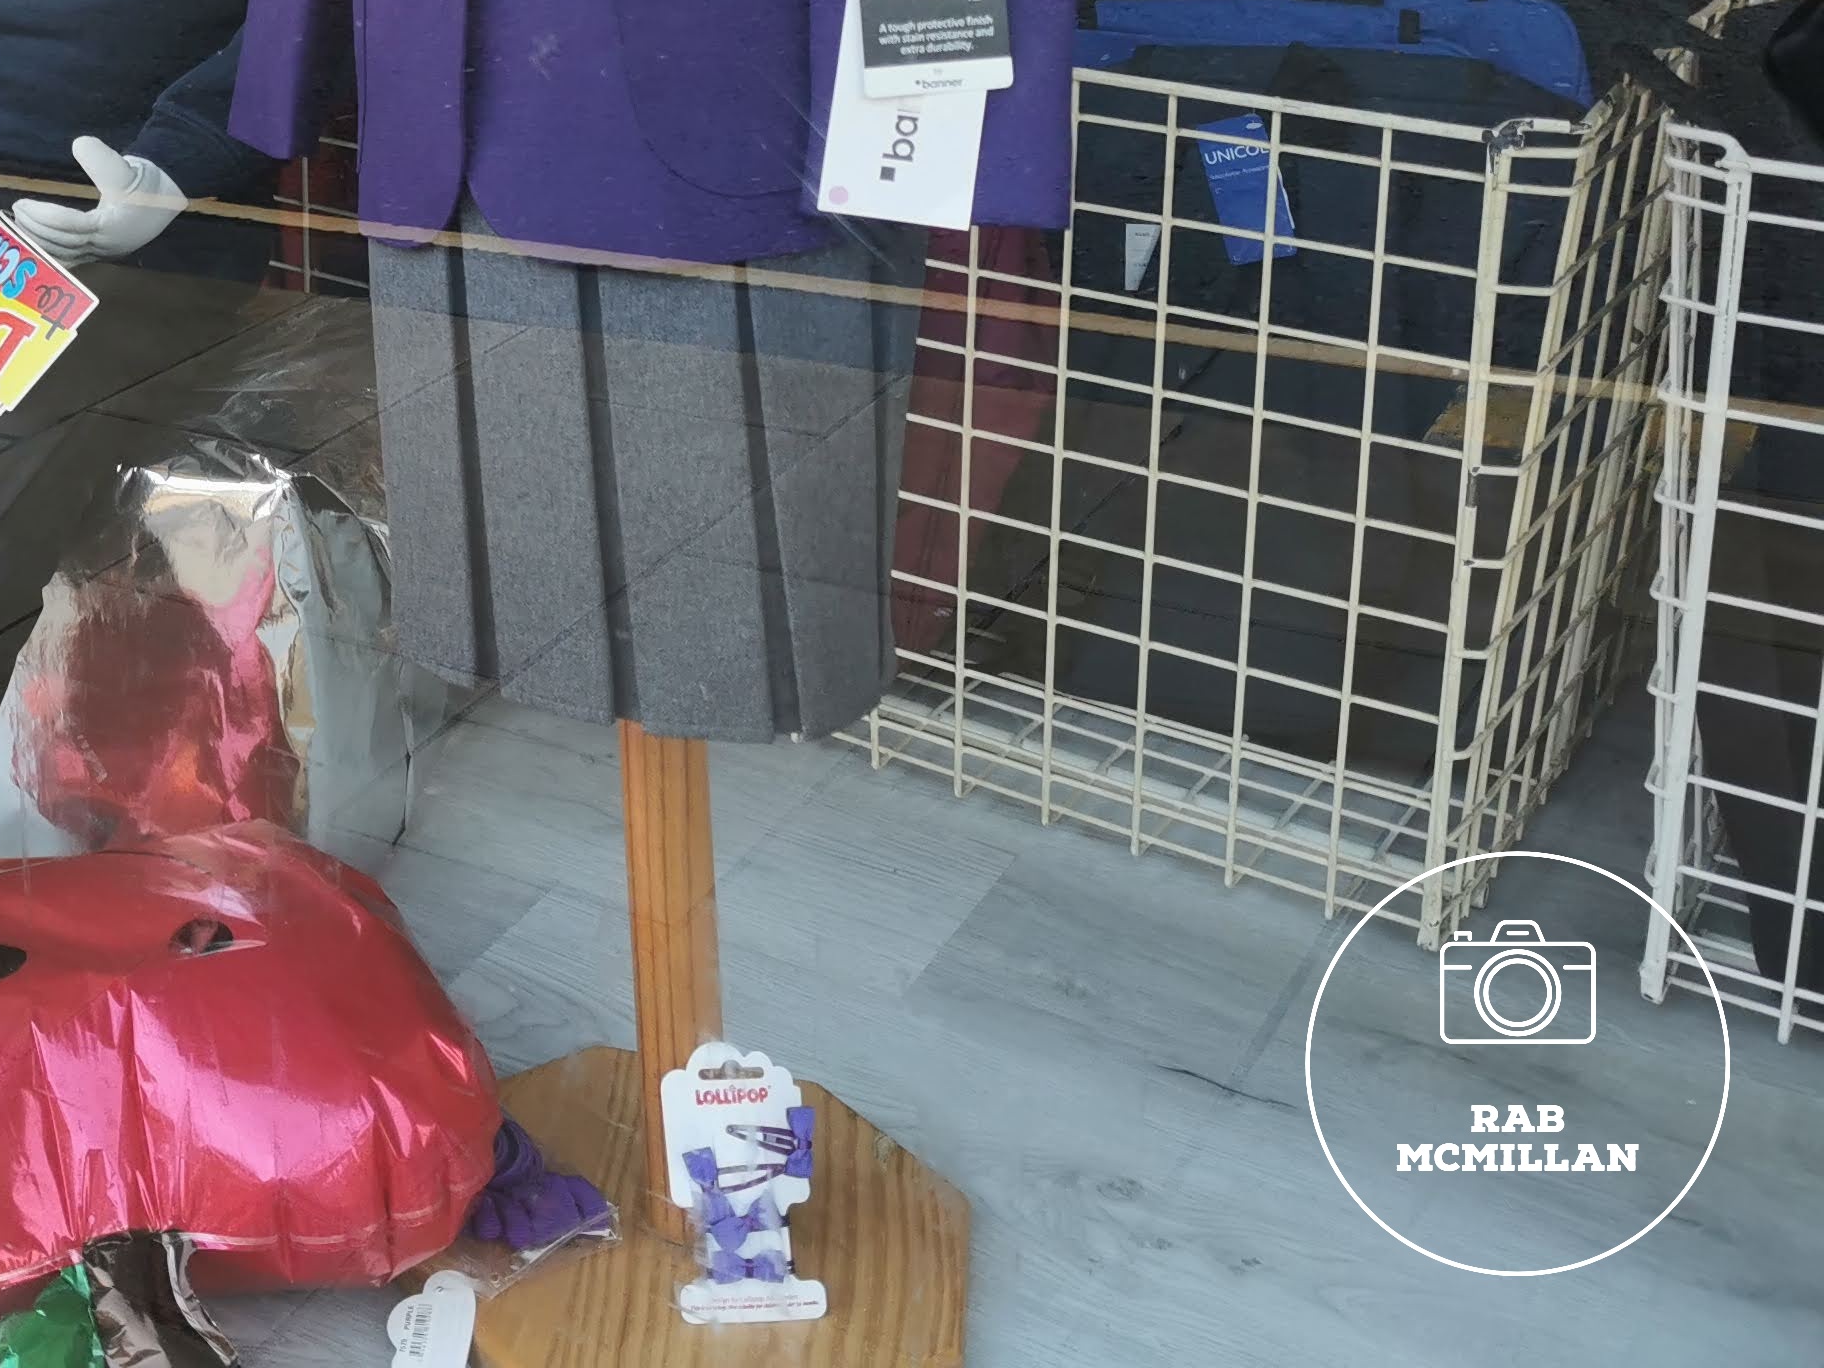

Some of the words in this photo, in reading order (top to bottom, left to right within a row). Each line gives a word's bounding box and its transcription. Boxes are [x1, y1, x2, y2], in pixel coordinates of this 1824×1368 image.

[879, 23, 887, 34] A
[887, 21, 916, 33] tough
[916, 18, 965, 32] protective
[965, 15, 994, 26] finish
[878, 34, 901, 45] with
[901, 33, 925, 44] stain
[925, 30, 974, 42] resistance
[974, 26, 994, 38] and
[900, 44, 925, 55] extra
[922, 78, 964, 89] banner
[695, 1086, 769, 1105] LOLLIPOP
[404, 1305, 415, 1330] PURPLE
